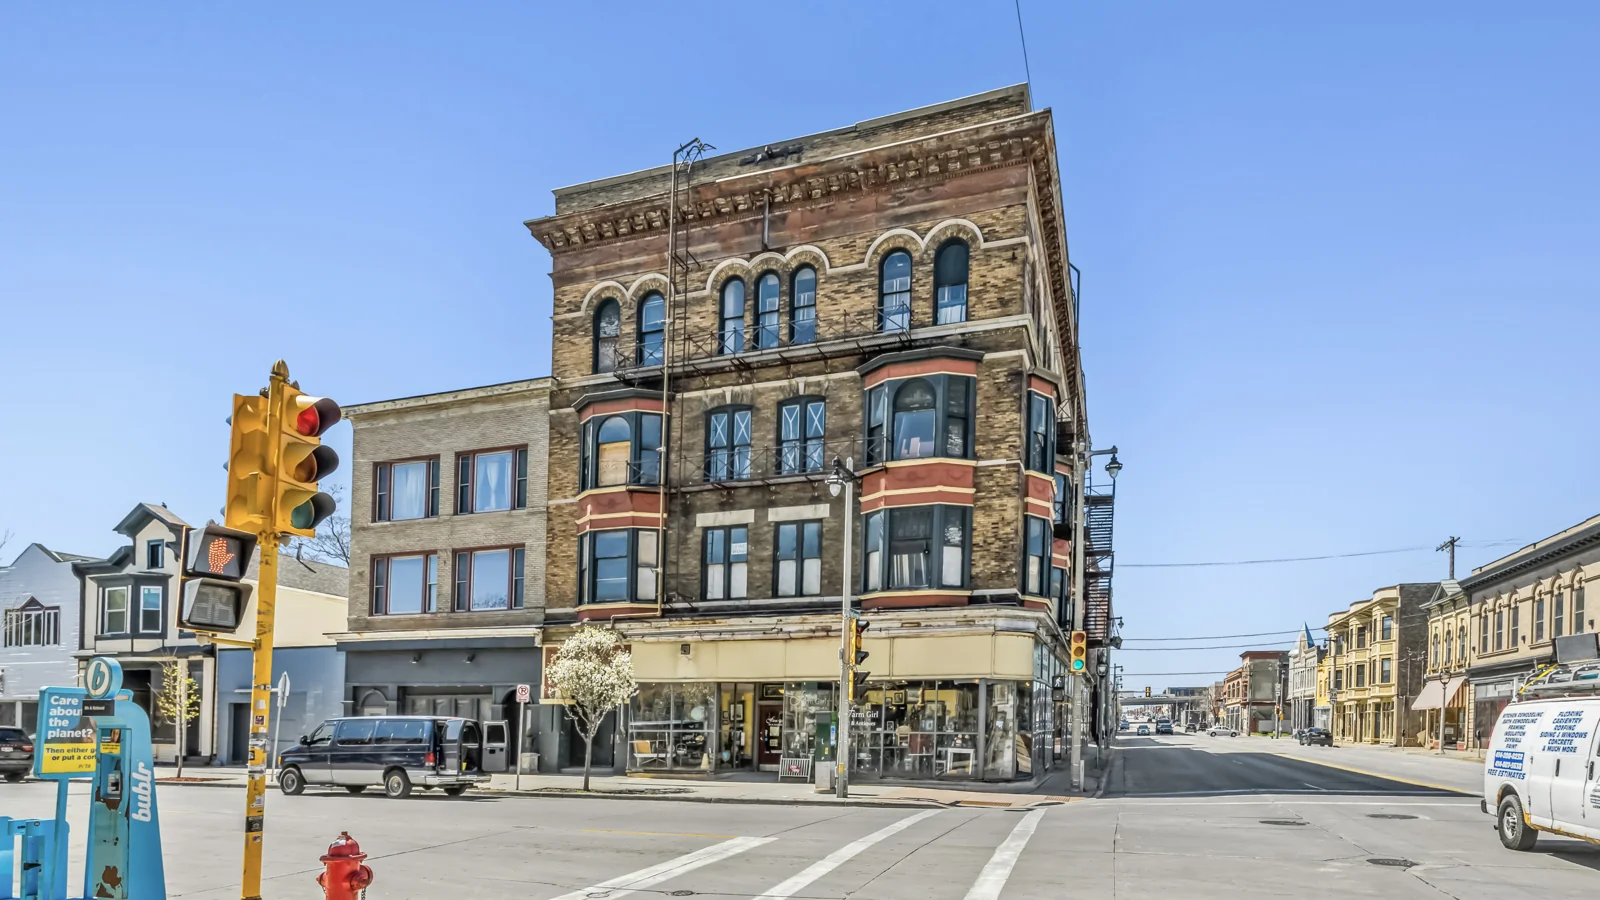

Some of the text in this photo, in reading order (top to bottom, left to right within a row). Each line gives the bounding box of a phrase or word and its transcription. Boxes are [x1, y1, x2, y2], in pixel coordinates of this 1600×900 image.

[50, 695, 79, 706] Care
[48, 717, 69, 727] the
[47, 728, 93, 739] planet?
[1561, 731, 1588, 739] WINDOWS
[1487, 768, 1526, 780] FREE ESTIMATES
[131, 761, 152, 822] bublr
